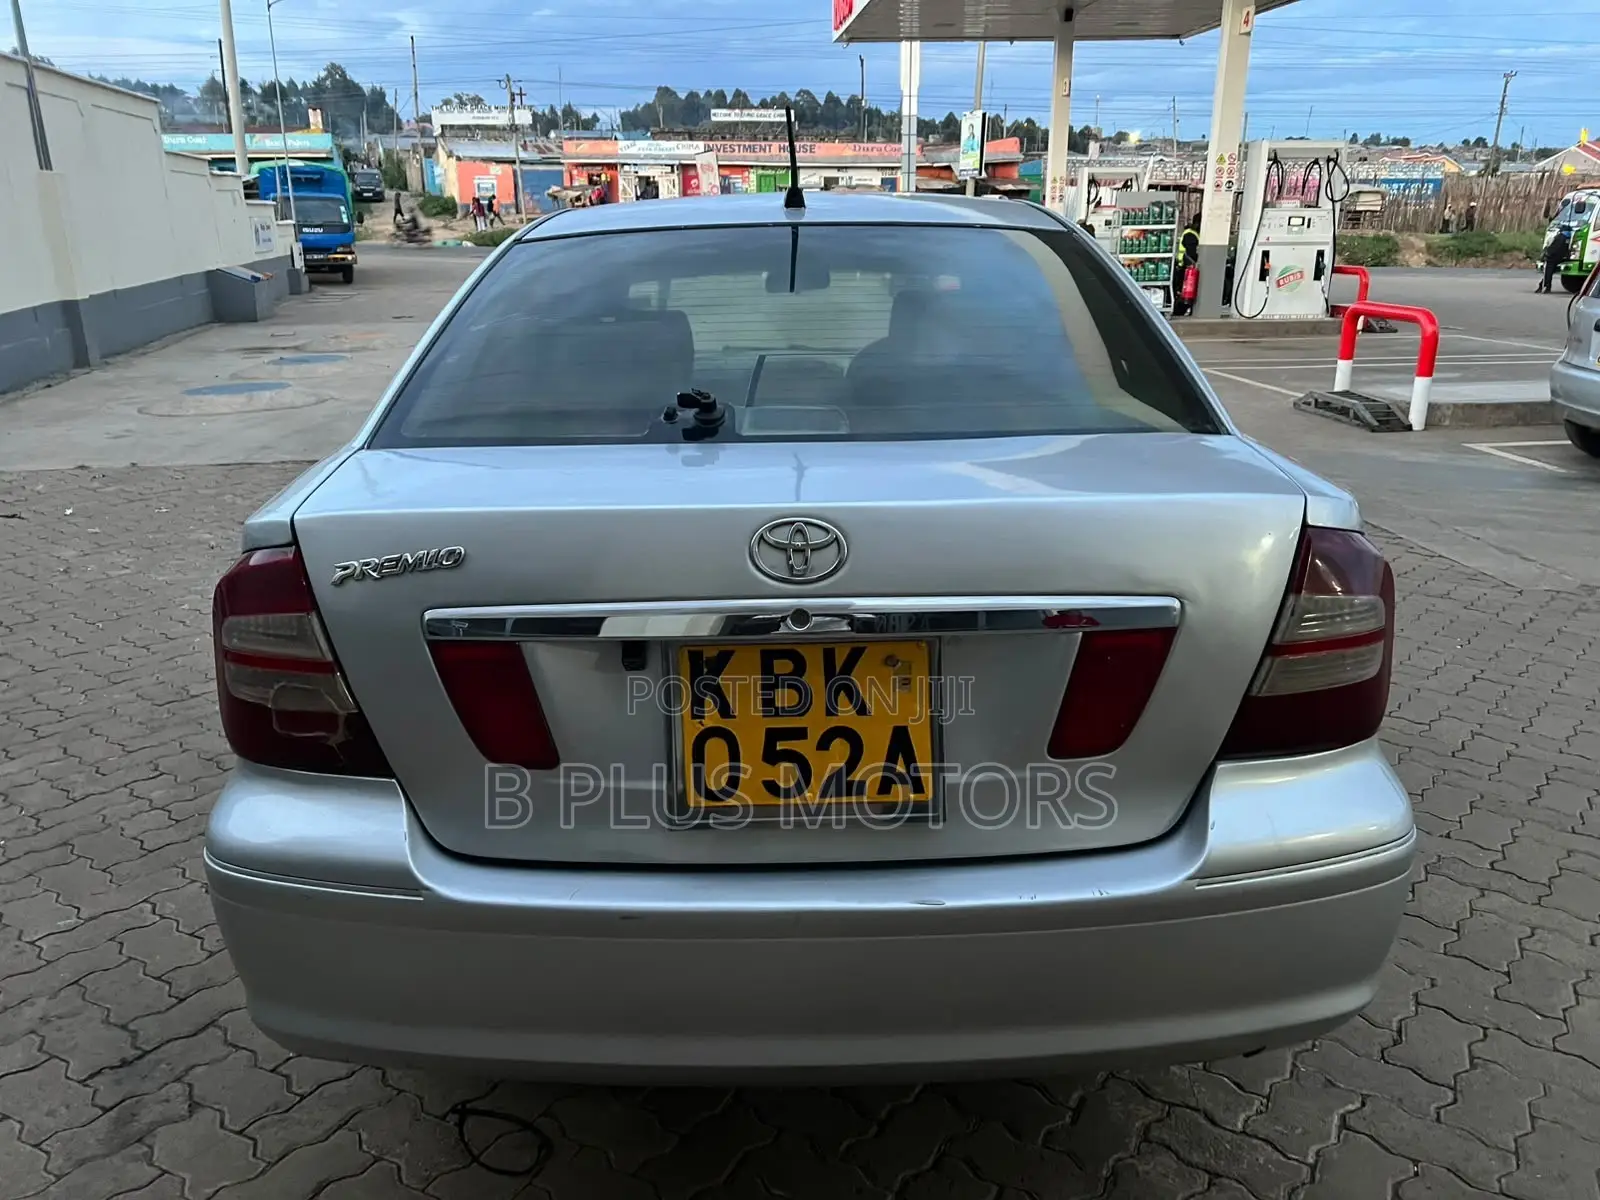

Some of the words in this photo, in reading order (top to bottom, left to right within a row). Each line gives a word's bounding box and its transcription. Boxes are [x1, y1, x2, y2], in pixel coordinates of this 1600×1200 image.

[1243, 10, 1250, 27] 4
[704, 144, 772, 154] INVESTMENT
[1278, 271, 1304, 287] RUBIS
[331, 545, 467, 586] PREMIO
[687, 645, 873, 721] KBK
[691, 725, 926, 802] 052A
